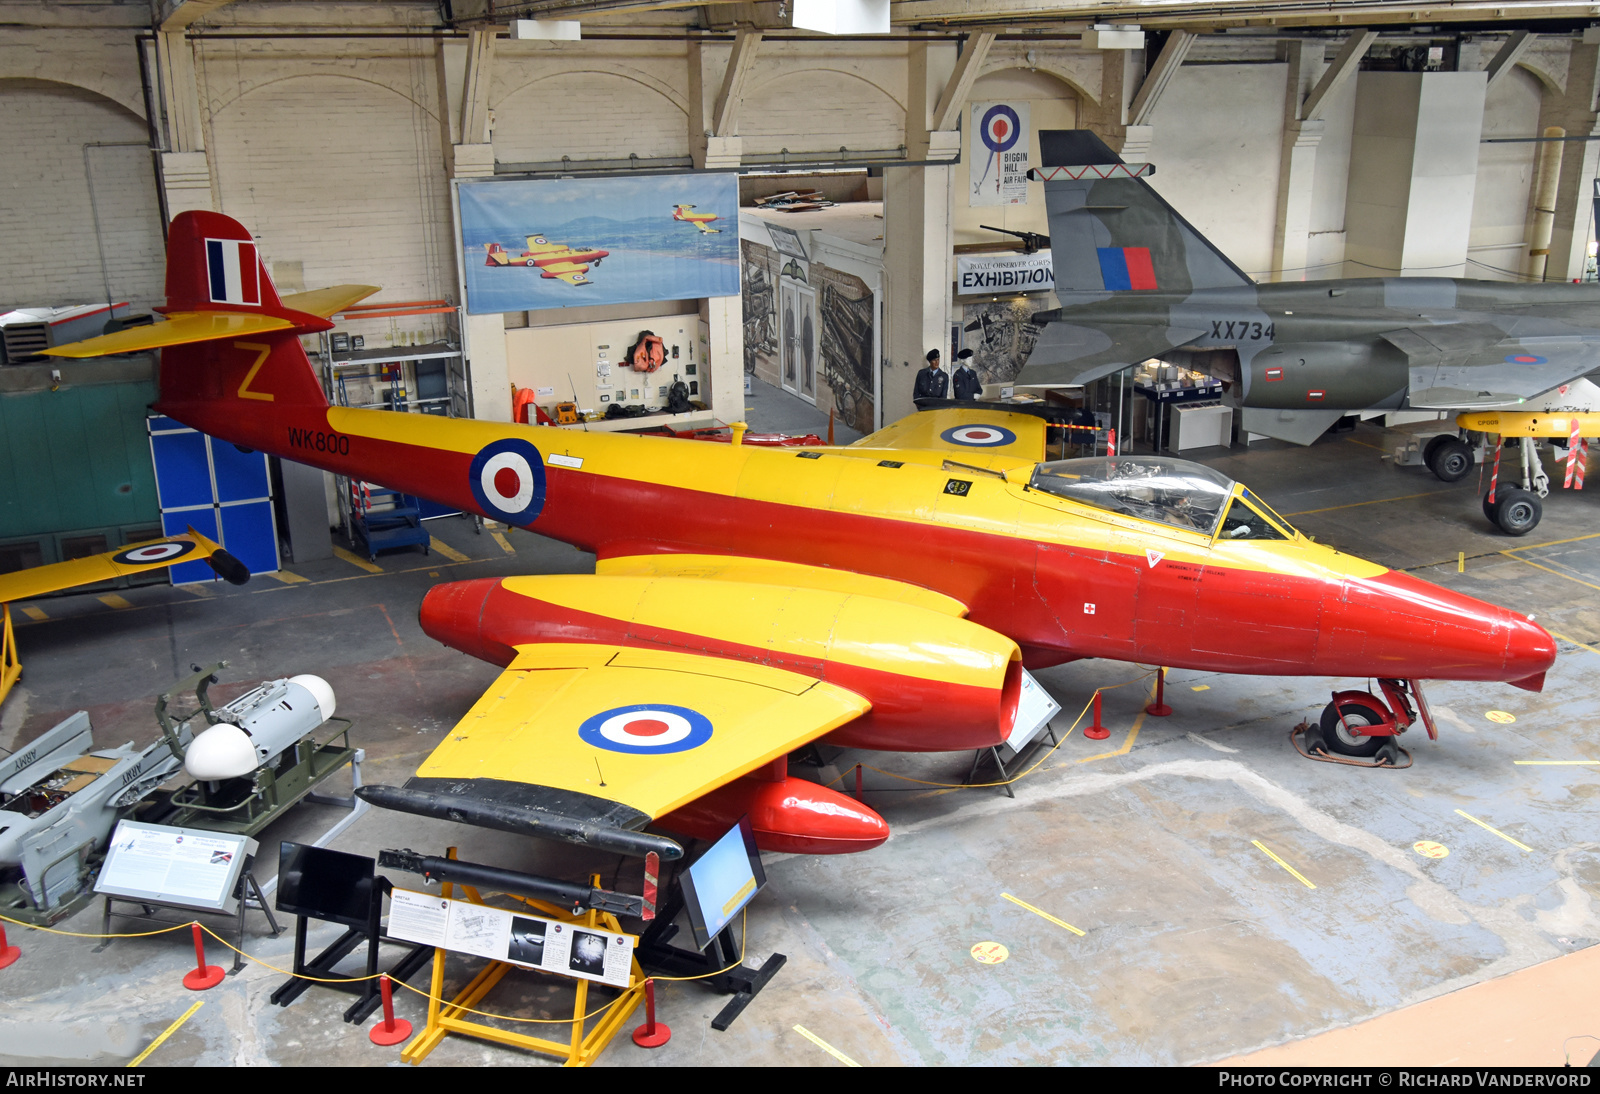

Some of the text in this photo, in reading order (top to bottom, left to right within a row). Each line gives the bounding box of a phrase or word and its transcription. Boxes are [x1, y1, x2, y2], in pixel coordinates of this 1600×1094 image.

[1004, 152, 1028, 163] BIGGIN
[1004, 163, 1019, 173] HILL
[1003, 175, 1027, 185] AIR FAIR
[970, 262, 991, 270] ROYAL
[992, 261, 1027, 269] OBSERVER
[962, 267, 1055, 287] EXHIBITION
[1210, 320, 1276, 341] XX734
[233, 340, 274, 402] Z
[288, 426, 350, 456] WK800
[14, 748, 37, 772] ARMY
[122, 762, 142, 786] ARMY
